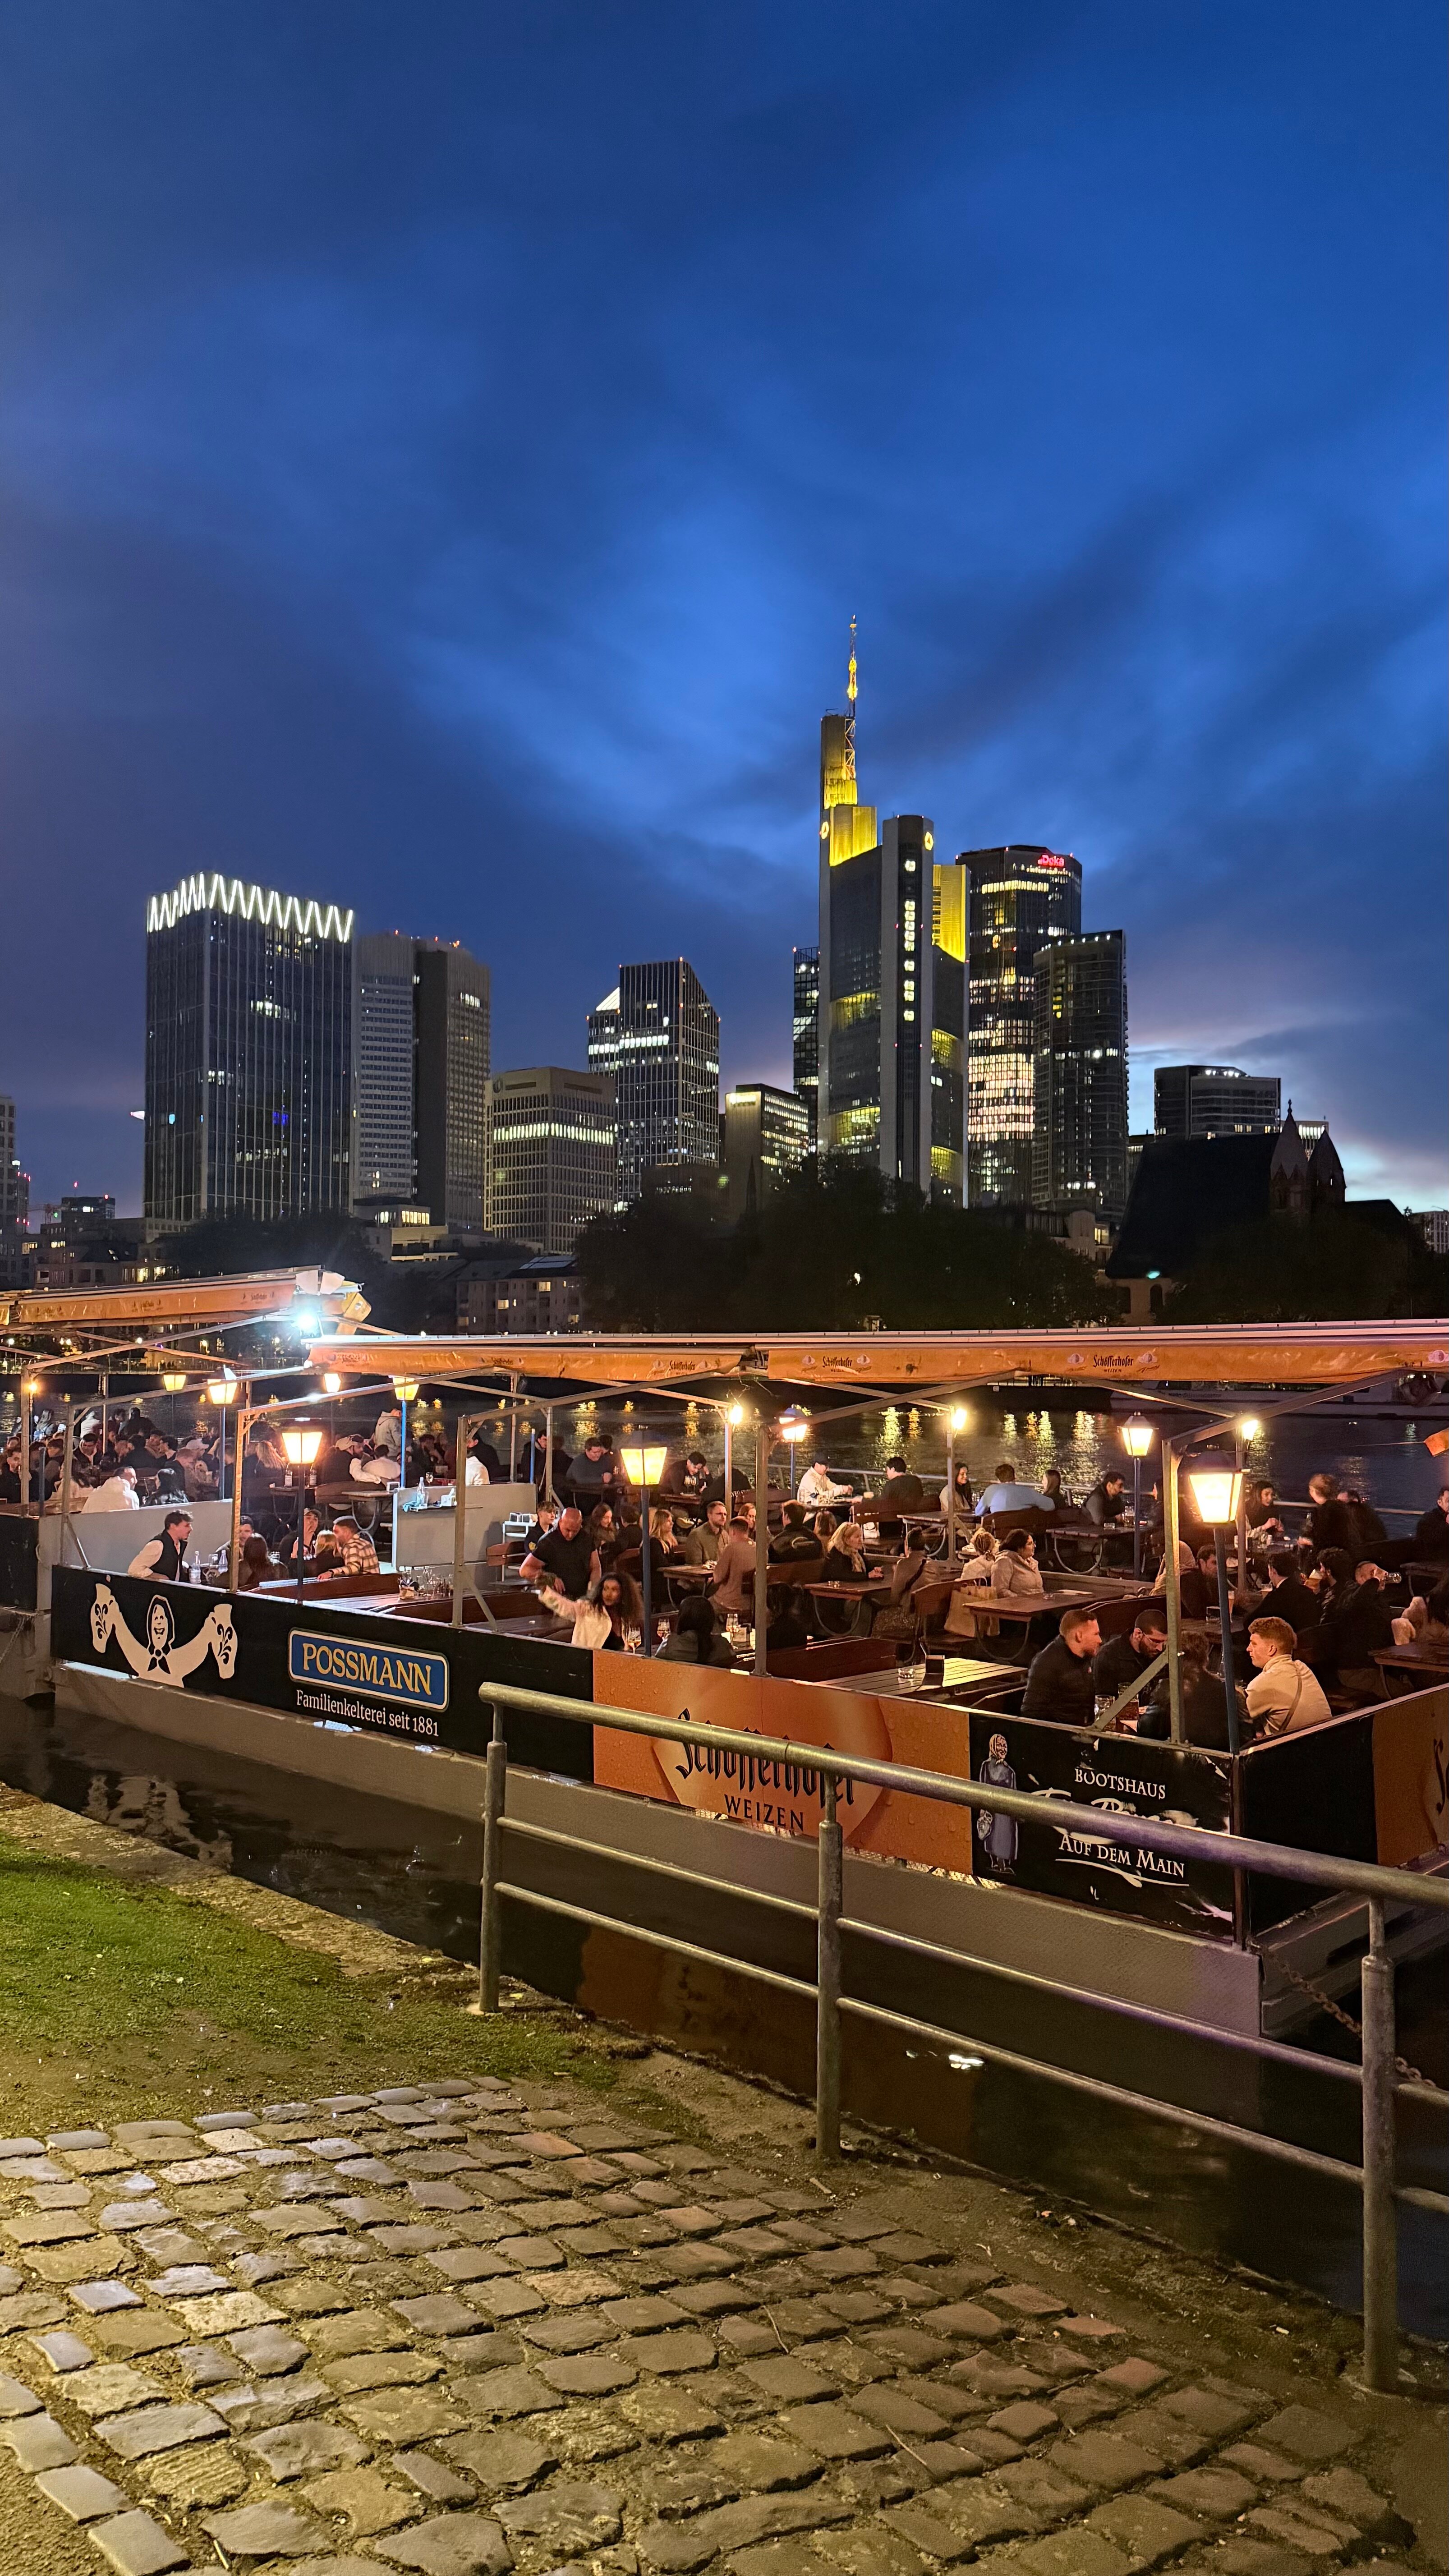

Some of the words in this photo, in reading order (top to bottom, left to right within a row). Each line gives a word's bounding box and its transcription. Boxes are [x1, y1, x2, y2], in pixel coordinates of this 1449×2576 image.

[303, 1643, 432, 1695] POSSMANN
[296, 1689, 386, 1725] Familienkelterei
[389, 1711, 410, 1730] seit
[412, 1716, 439, 1736] 1881
[1074, 1768, 1165, 1800] BOOTSHAUS
[724, 1794, 804, 1832] WEIZEN
